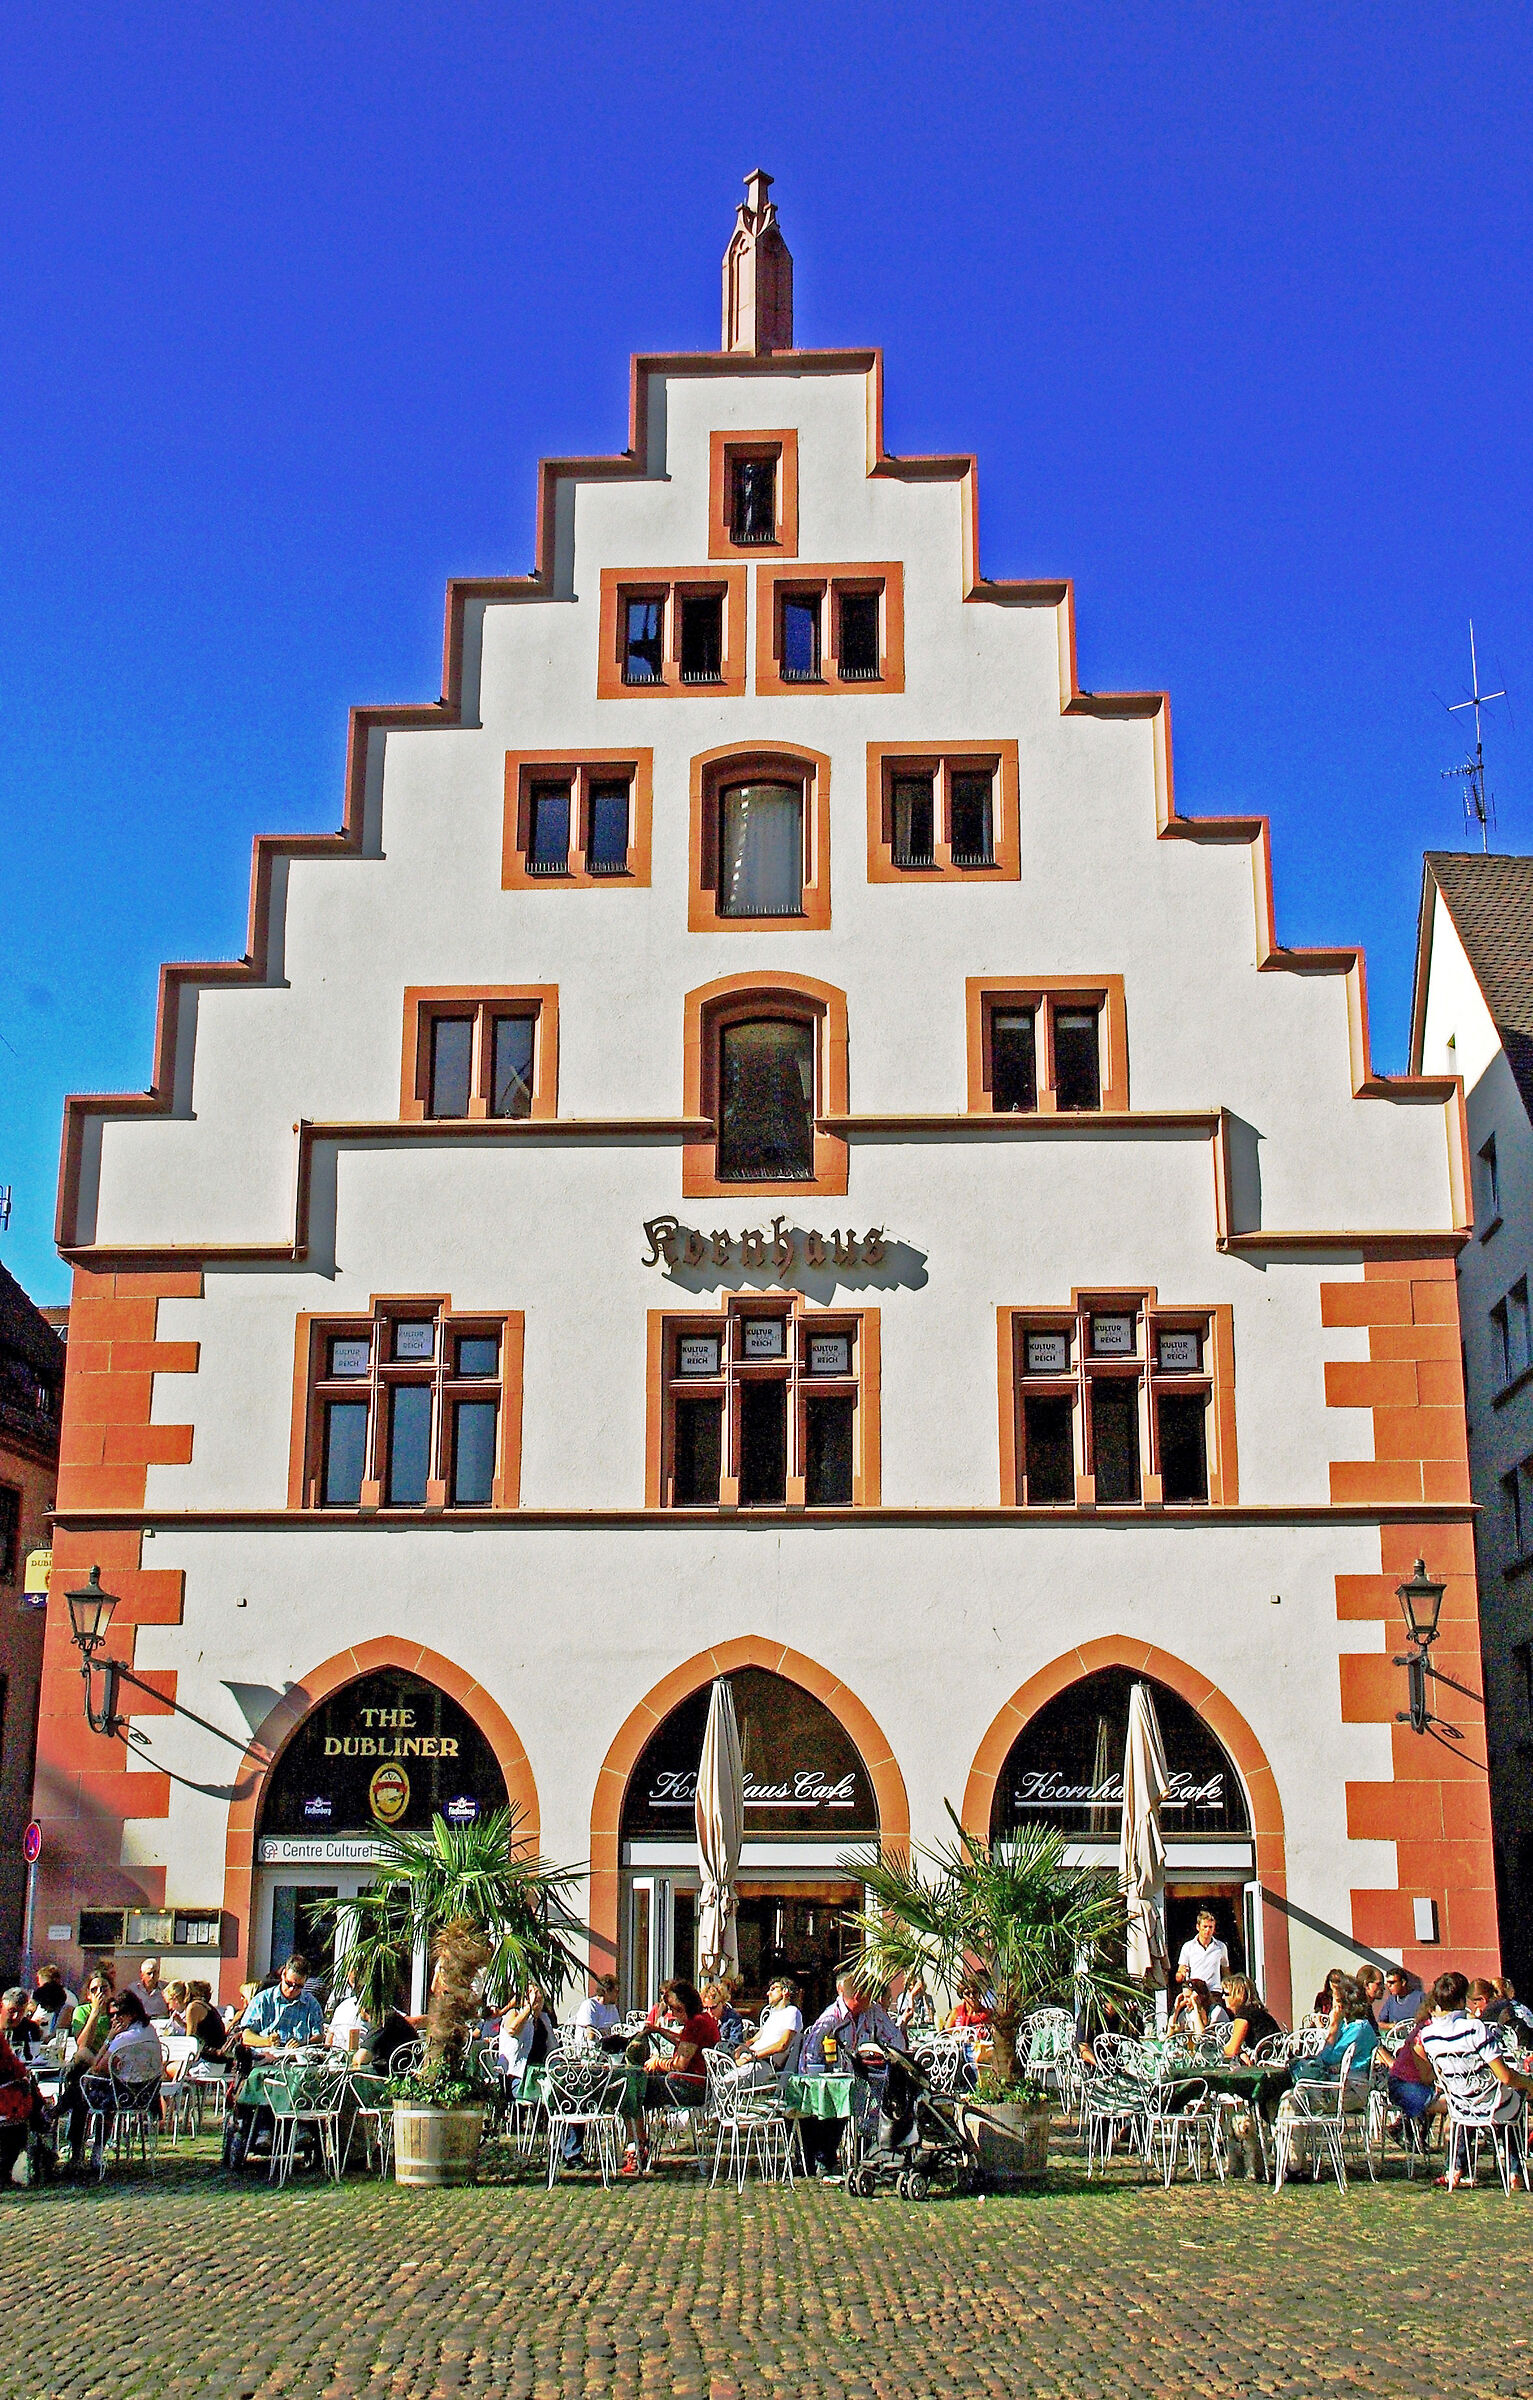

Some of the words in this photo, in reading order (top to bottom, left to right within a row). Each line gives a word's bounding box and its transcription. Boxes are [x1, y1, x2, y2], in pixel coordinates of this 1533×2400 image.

[641, 1215, 886, 1280] Kornhaus
[747, 1328, 773, 1336] KULTUR
[687, 1357, 708, 1365] REICH
[817, 1356, 838, 1364] REICH
[1035, 1354, 1056, 1362] REICH
[360, 1707, 417, 1728] THE
[323, 1736, 459, 1757] DUBLINER
[794, 1771, 855, 1799] Cafe
[1014, 1771, 1124, 1799] Kornha
[283, 1842, 323, 1857] Centre
[326, 1842, 373, 1858] Culturel
